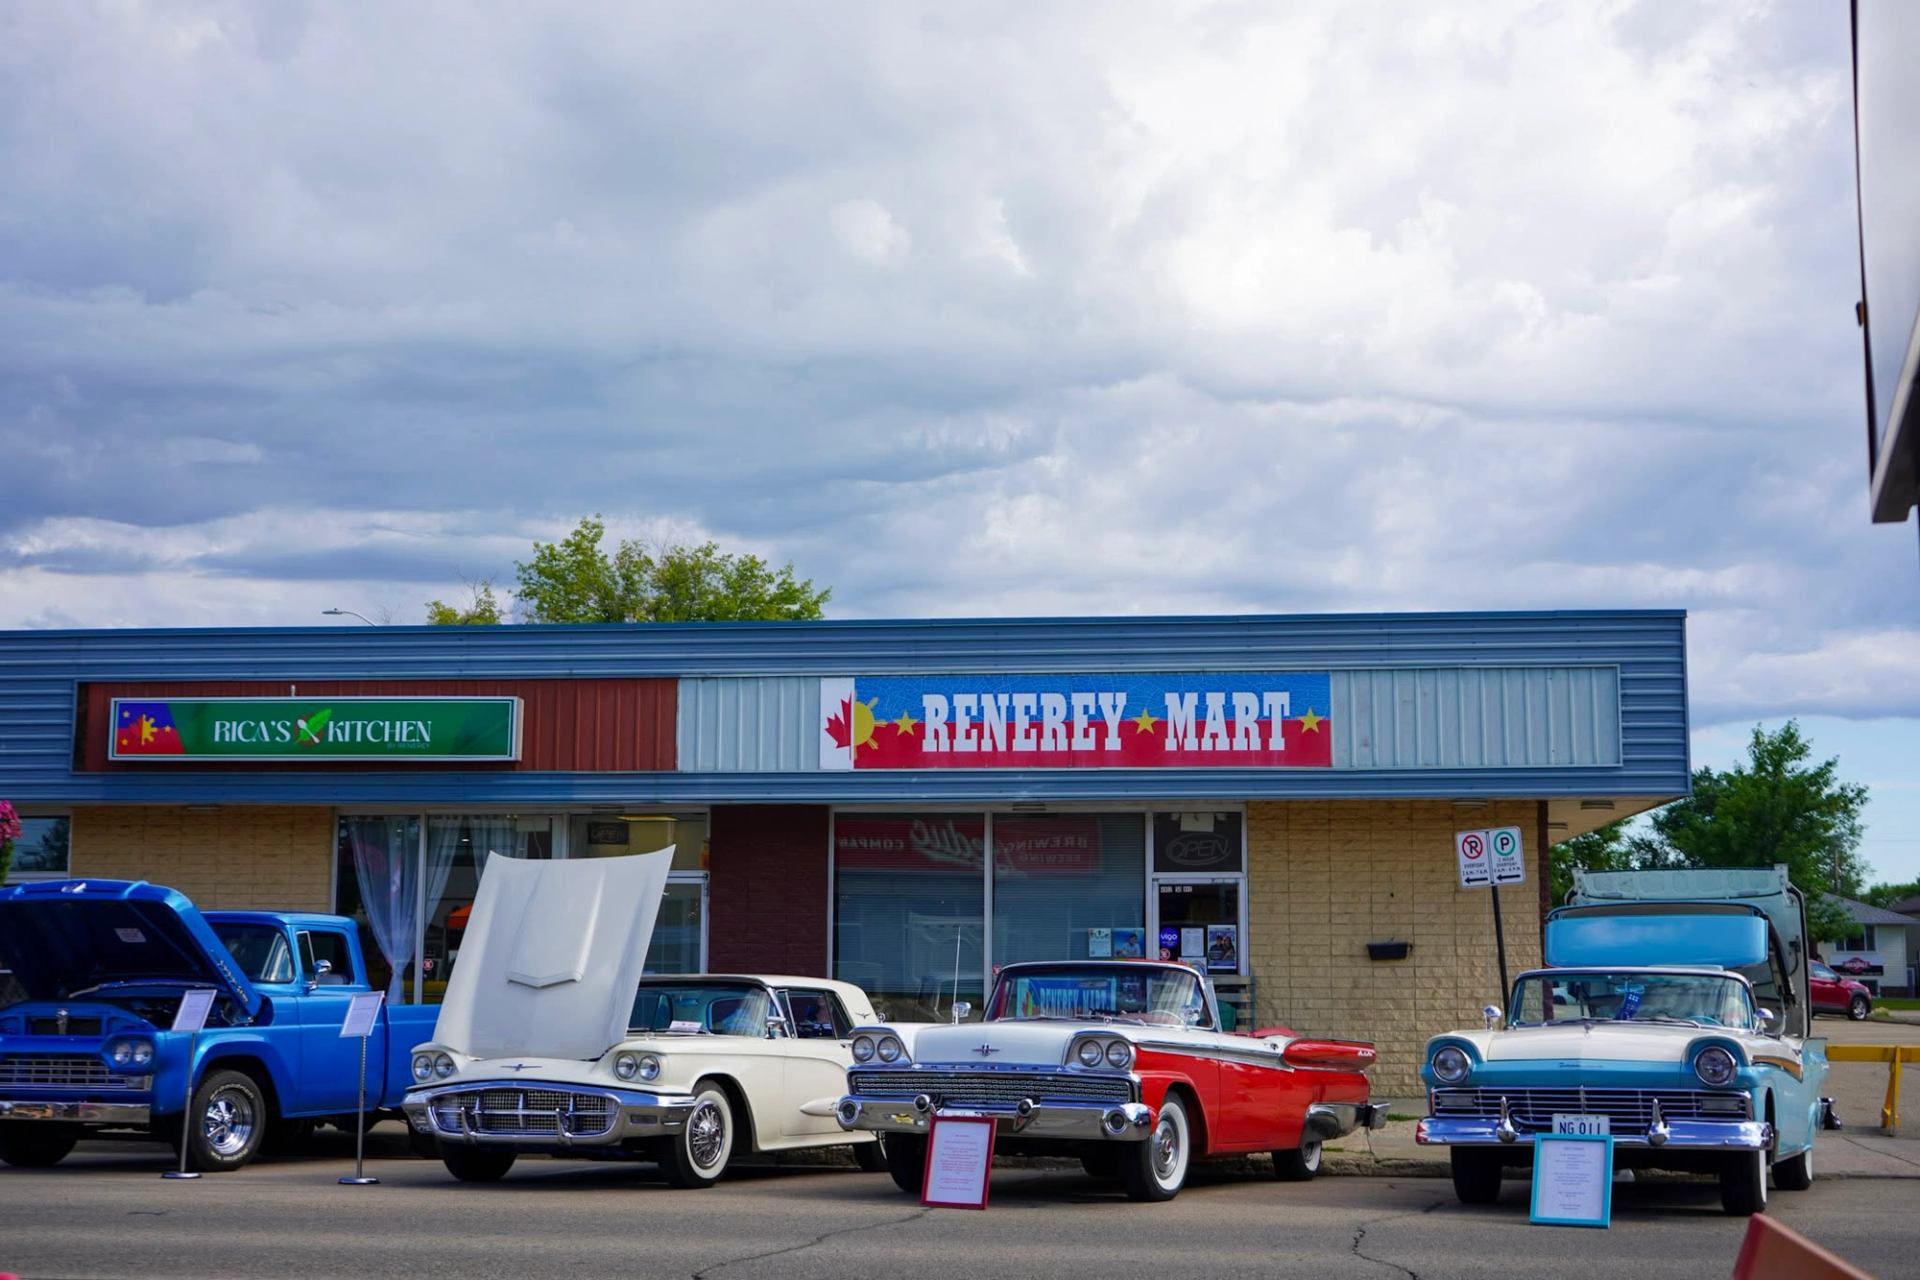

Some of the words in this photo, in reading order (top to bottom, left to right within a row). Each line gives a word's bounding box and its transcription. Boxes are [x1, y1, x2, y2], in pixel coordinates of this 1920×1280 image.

[213, 720, 292, 743] RICA'S
[327, 720, 432, 743] KITCHEN
[921, 692, 1127, 753] RENEREY
[1164, 691, 1290, 751] MART
[1168, 839, 1229, 858] OPEN
[1160, 932, 1178, 941] vigo
[1559, 1122, 1574, 1134] NG
